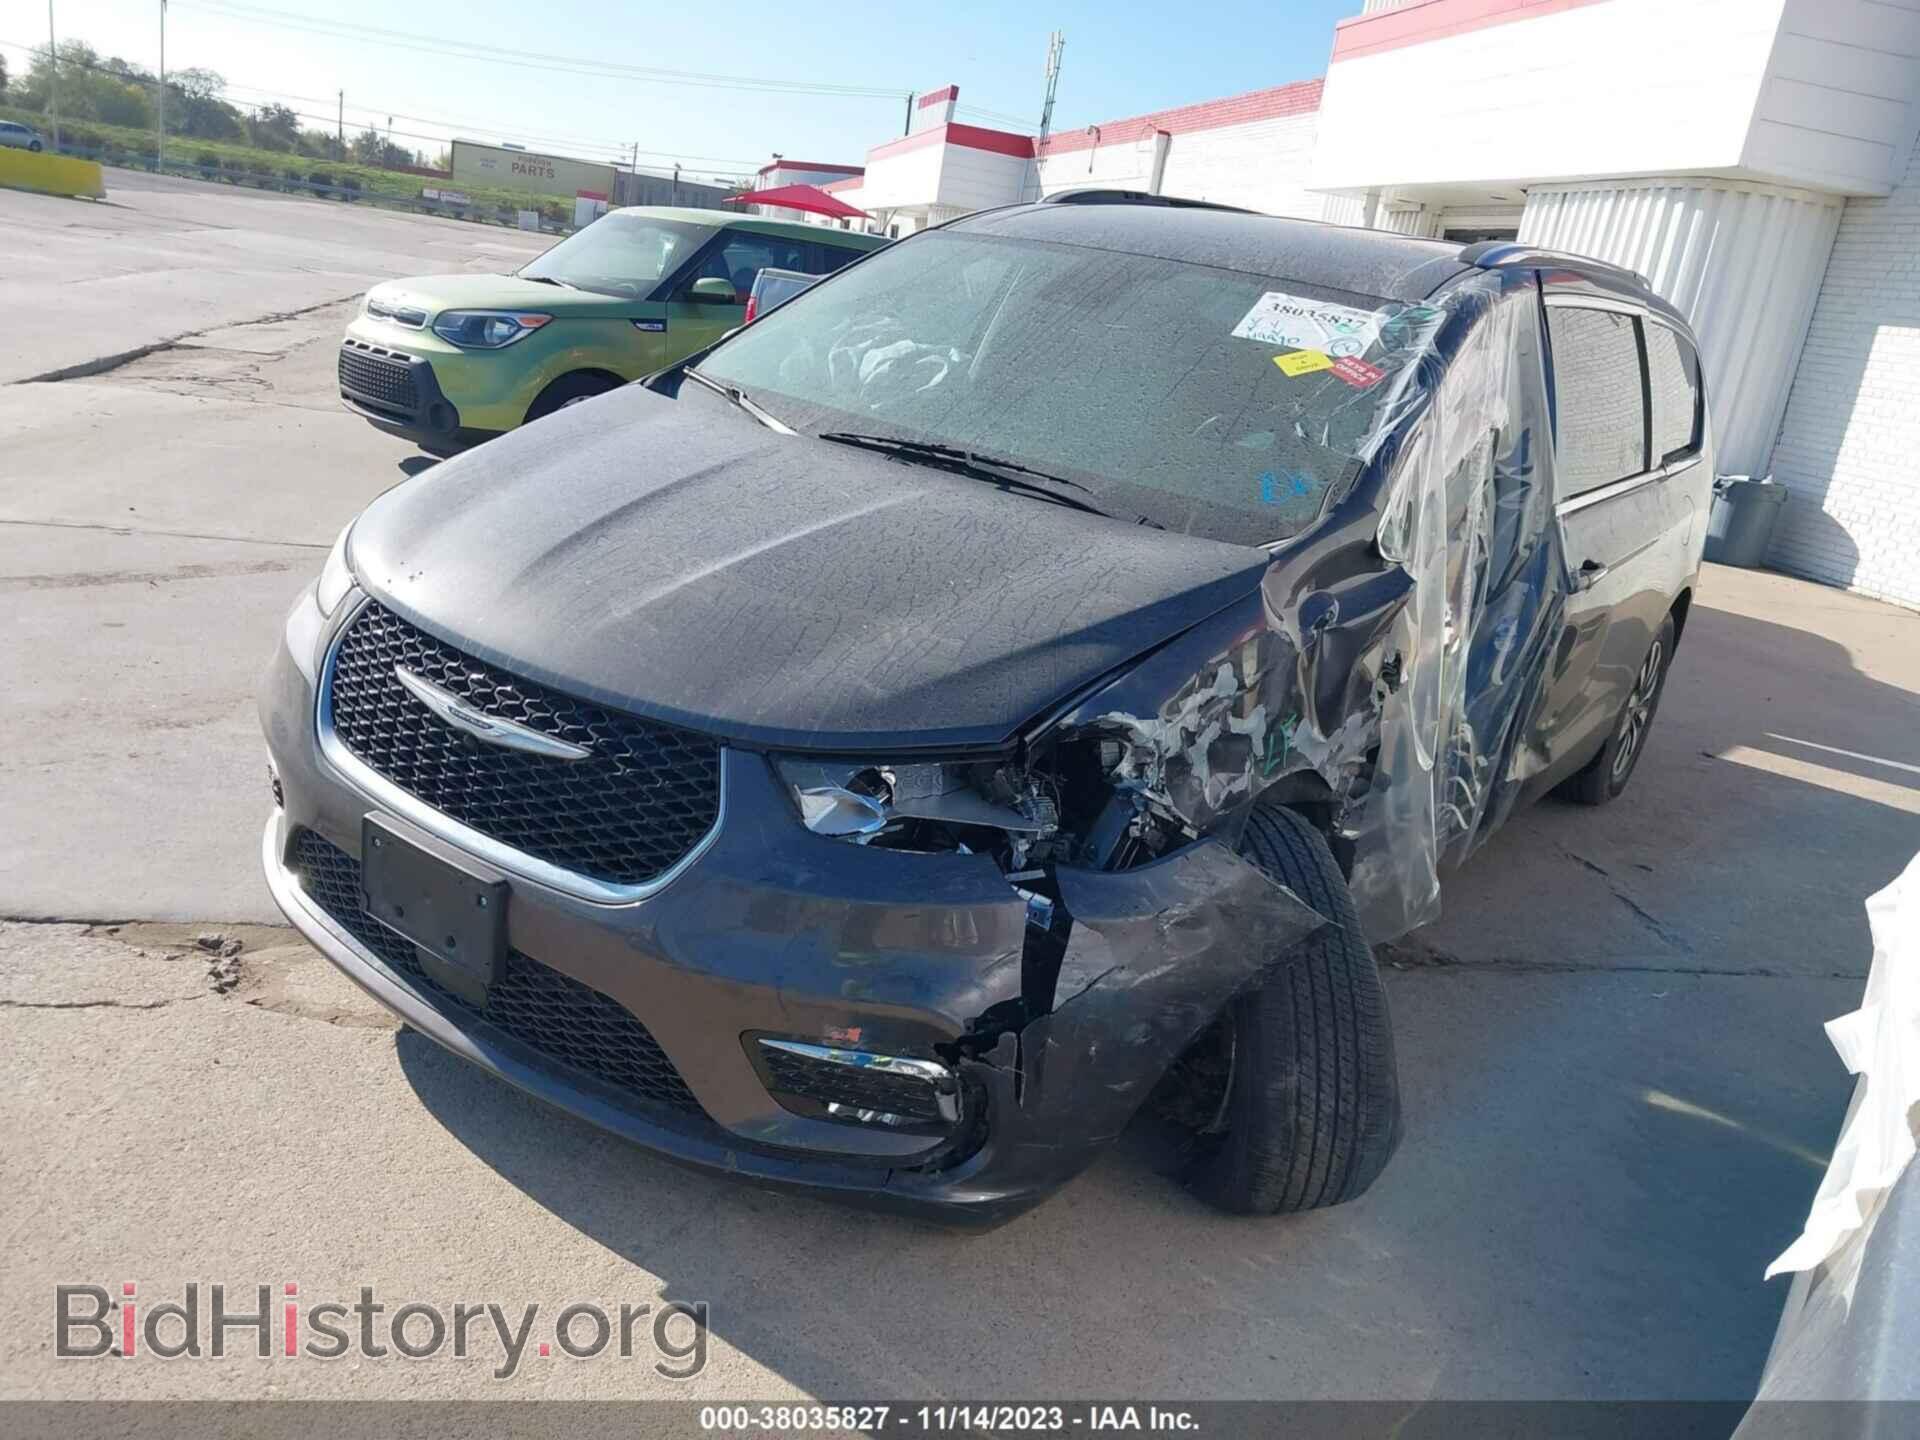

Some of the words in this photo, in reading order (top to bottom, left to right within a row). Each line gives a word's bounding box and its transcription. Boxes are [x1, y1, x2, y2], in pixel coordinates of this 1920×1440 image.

[511, 162, 555, 178] PARTS
[1335, 363, 1368, 382] OFFICE
[1343, 358, 1367, 373] KEYS
